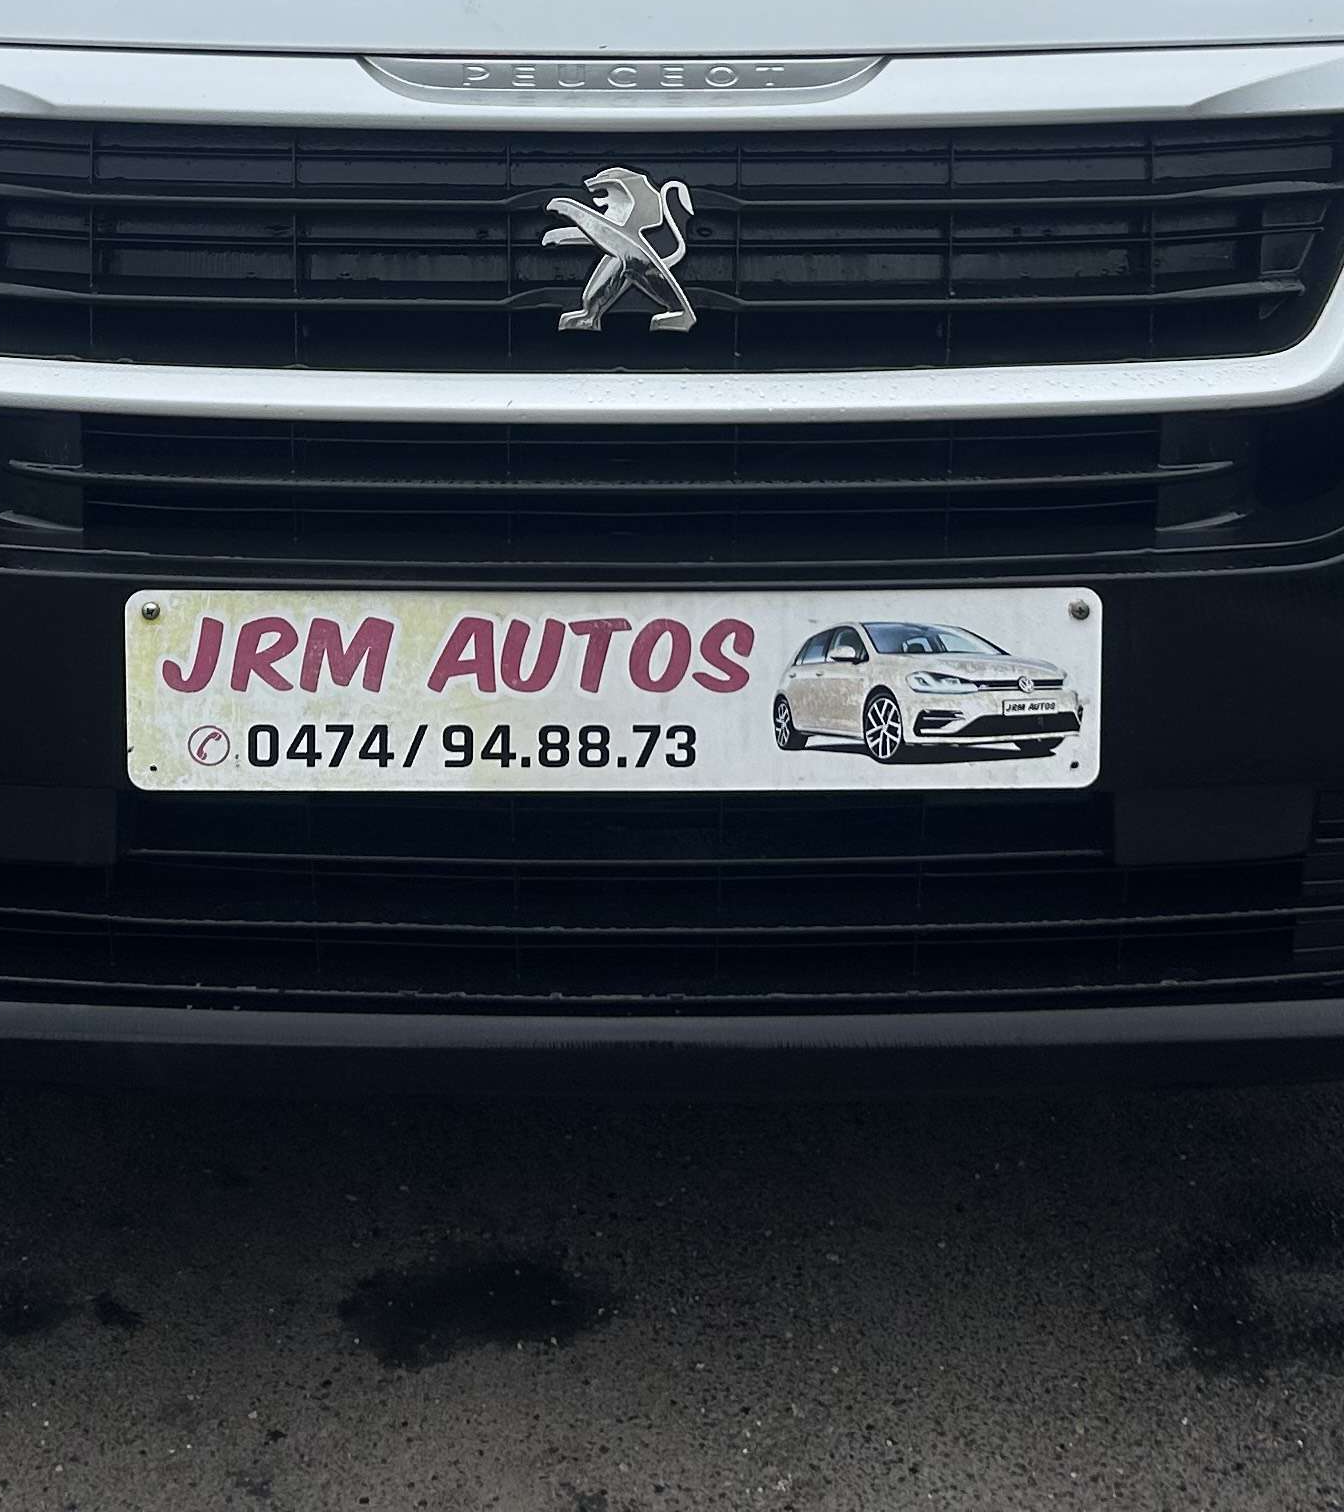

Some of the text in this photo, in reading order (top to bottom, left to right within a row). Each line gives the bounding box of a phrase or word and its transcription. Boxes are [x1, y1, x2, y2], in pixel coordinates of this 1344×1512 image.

[462, 64, 785, 87] PEUGEOT
[162, 616, 756, 694] JRM AUTOS
